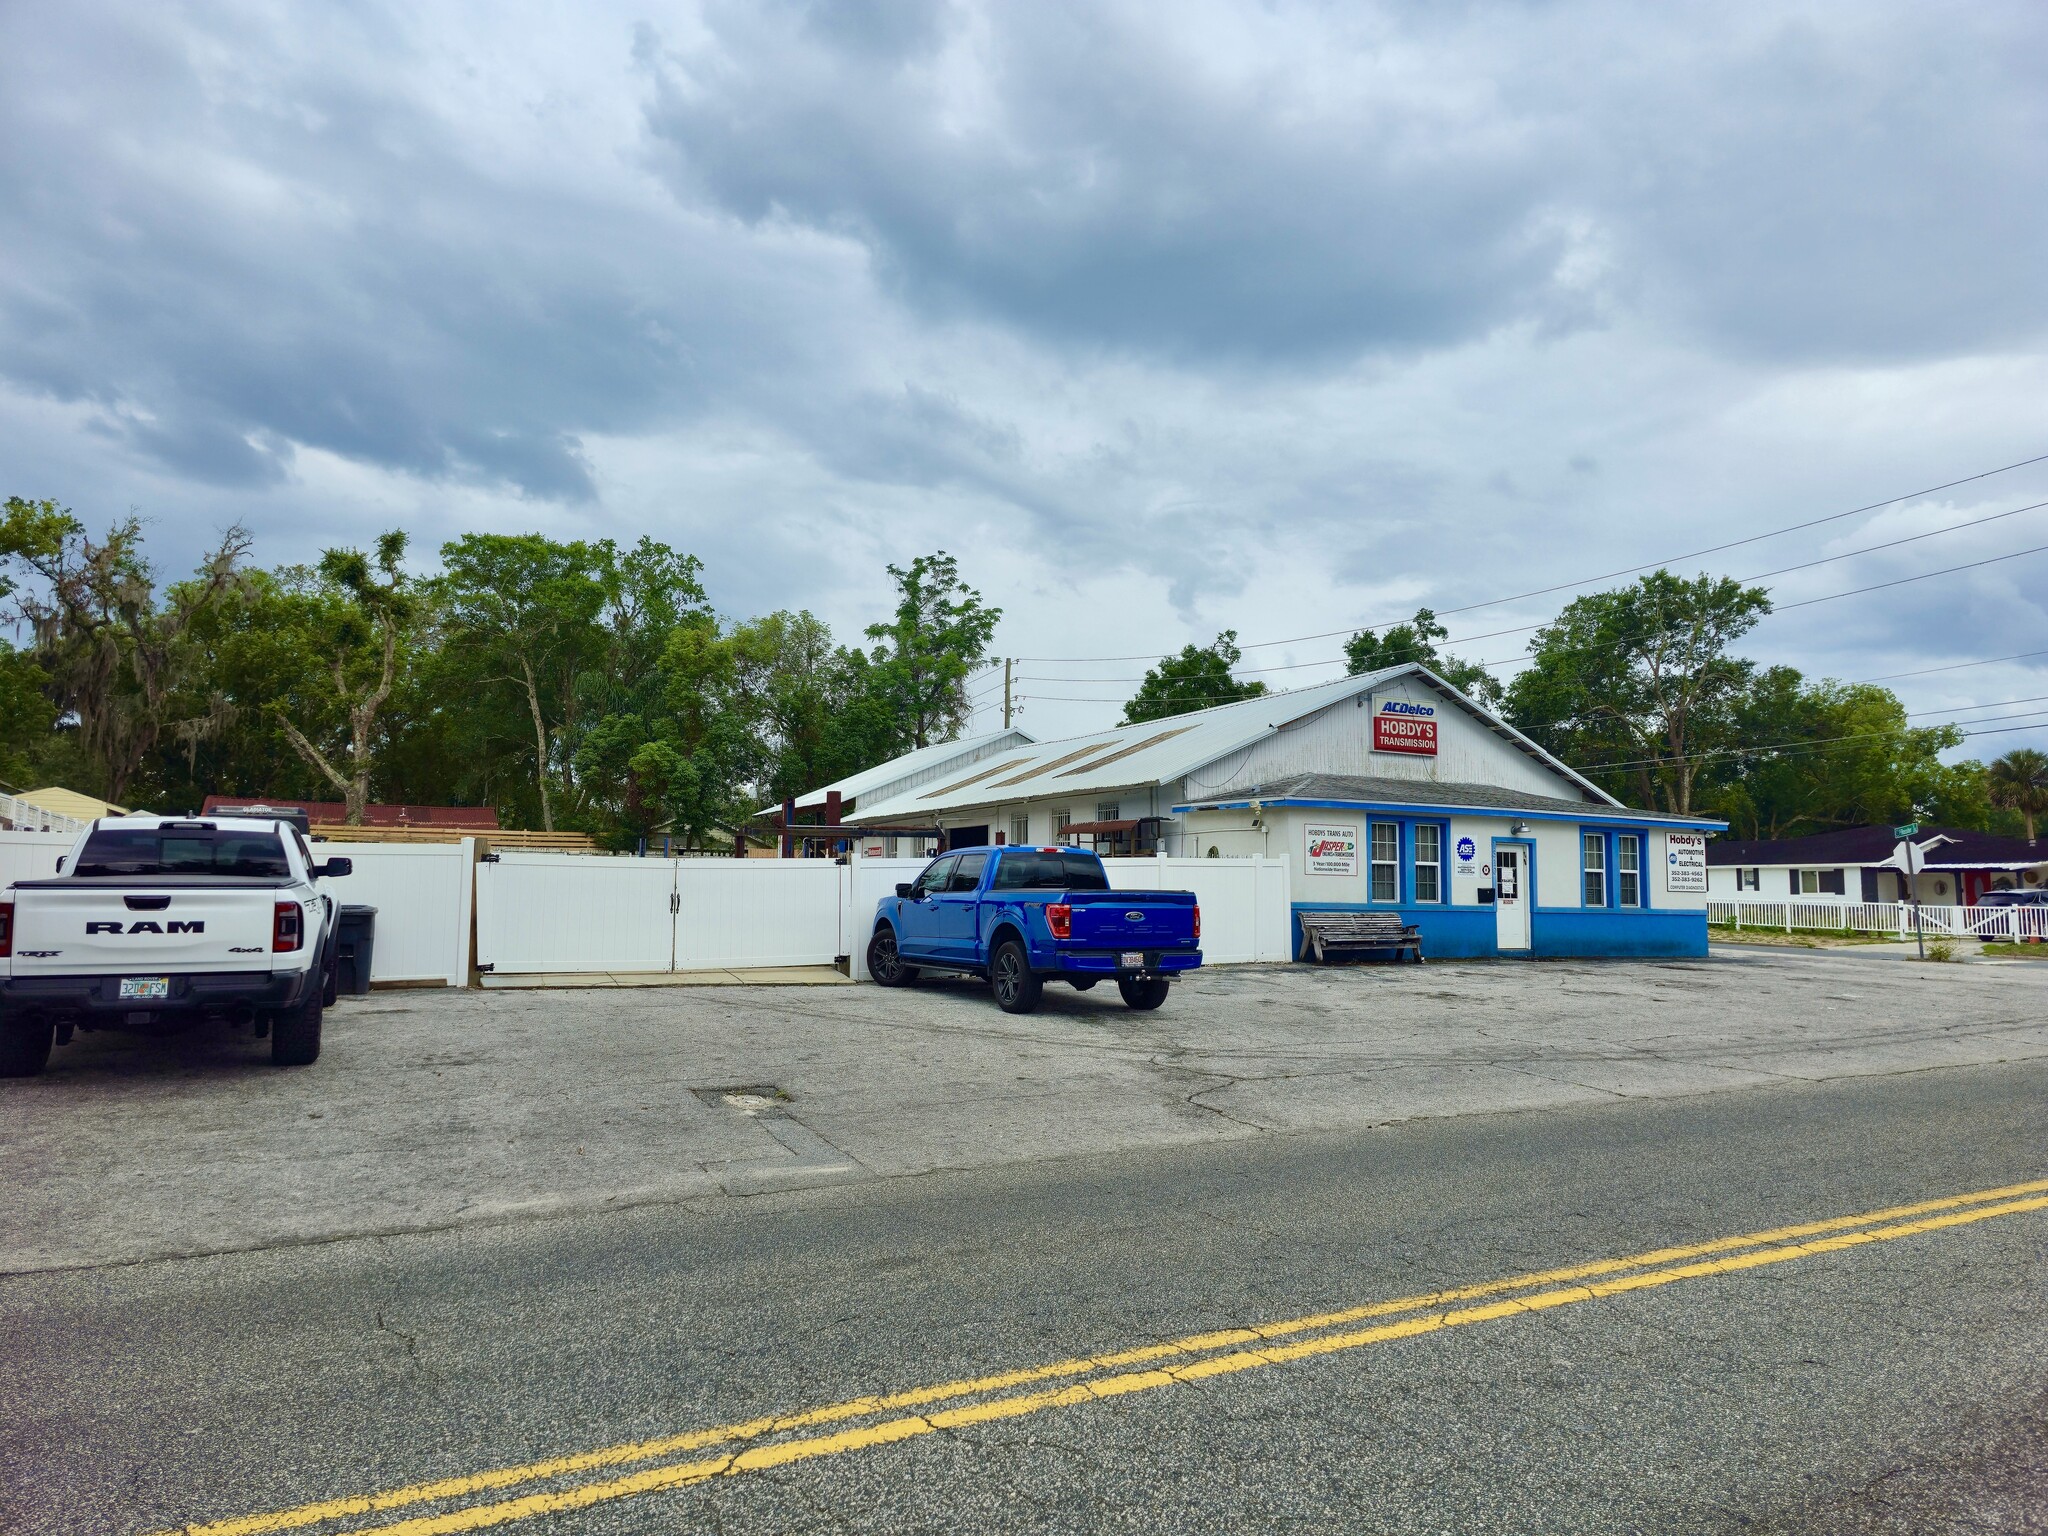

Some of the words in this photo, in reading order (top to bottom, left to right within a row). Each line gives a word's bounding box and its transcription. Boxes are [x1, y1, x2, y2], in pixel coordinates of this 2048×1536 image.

[1382, 701, 1435, 716] ACDelco
[1381, 720, 1434, 738] HOBDY'S
[1380, 736, 1435, 749] TRANSMISSION
[1327, 830, 1341, 838] TRANS
[1670, 834, 1702, 847] Hobdy's
[1312, 840, 1345, 857] JASPER
[1460, 844, 1473, 853] ASE
[86, 921, 205, 935] RAM
